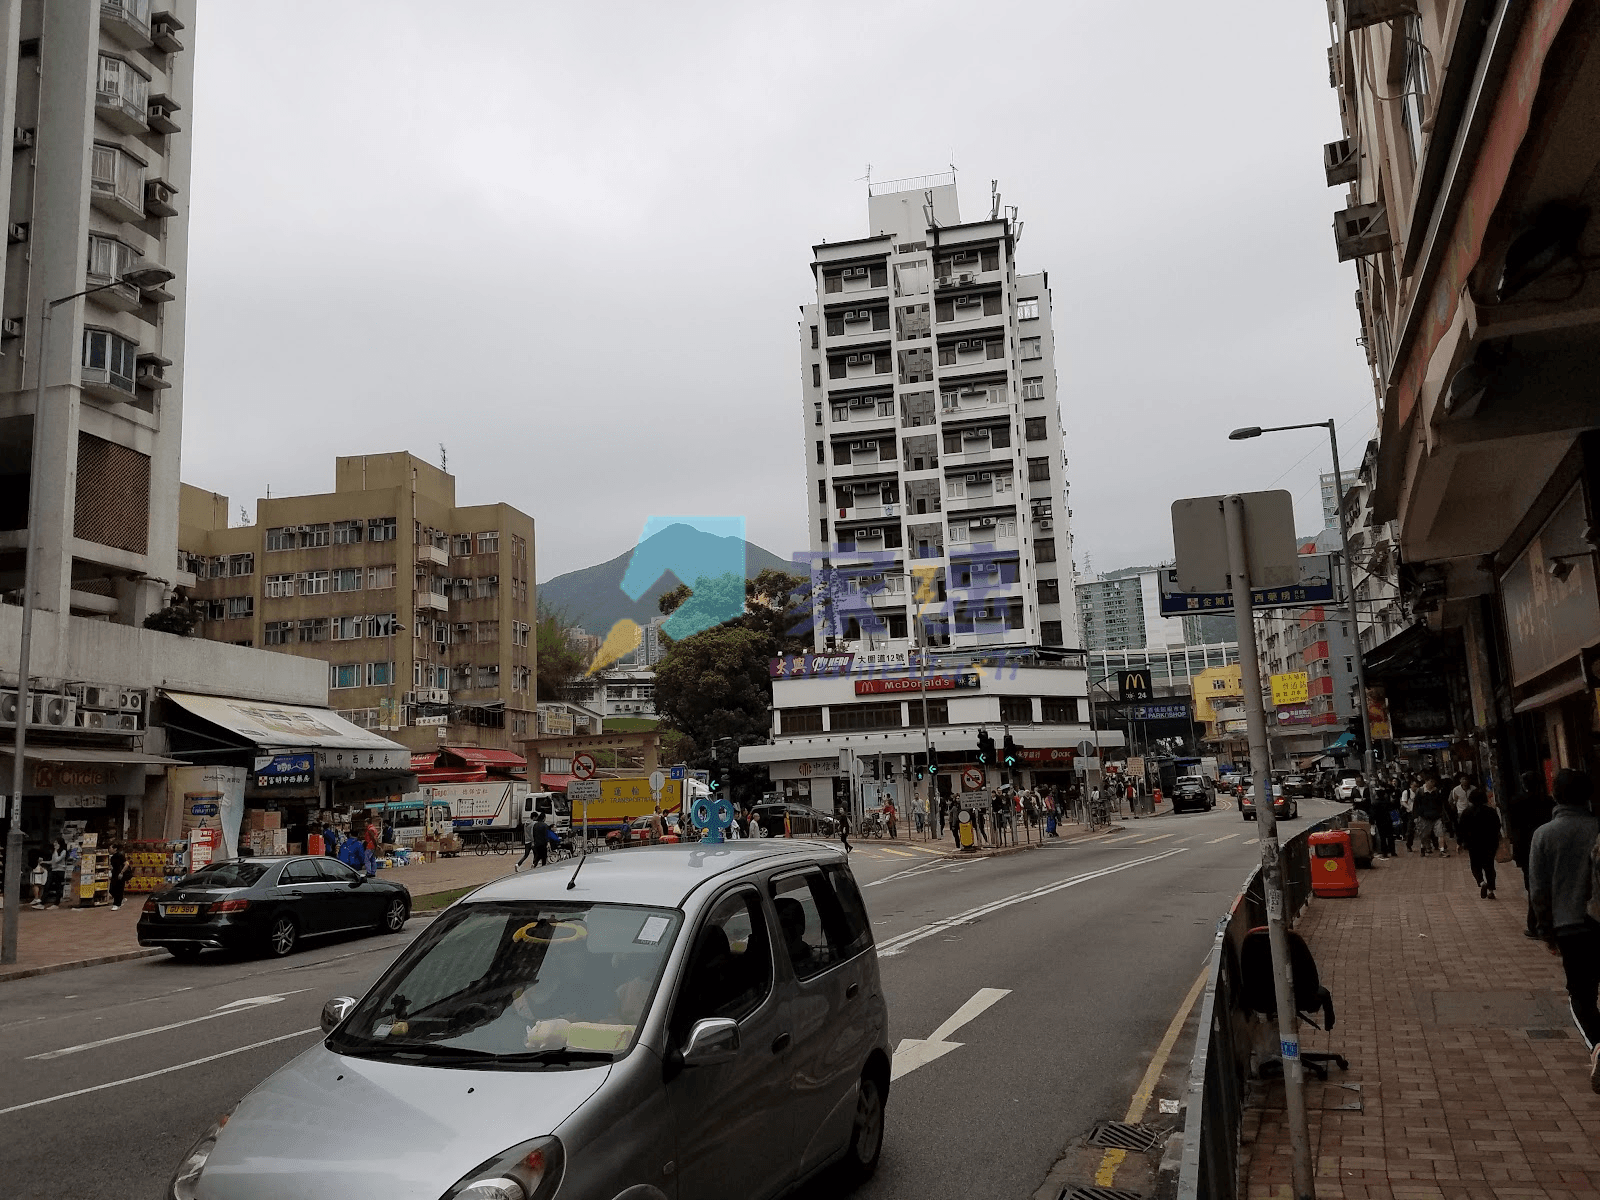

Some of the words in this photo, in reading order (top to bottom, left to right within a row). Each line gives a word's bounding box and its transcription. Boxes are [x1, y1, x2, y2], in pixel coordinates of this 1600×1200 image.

[884, 678, 950, 690] McDonald's
[1137, 691, 1148, 699] 24
[61, 771, 103, 784] Circle
